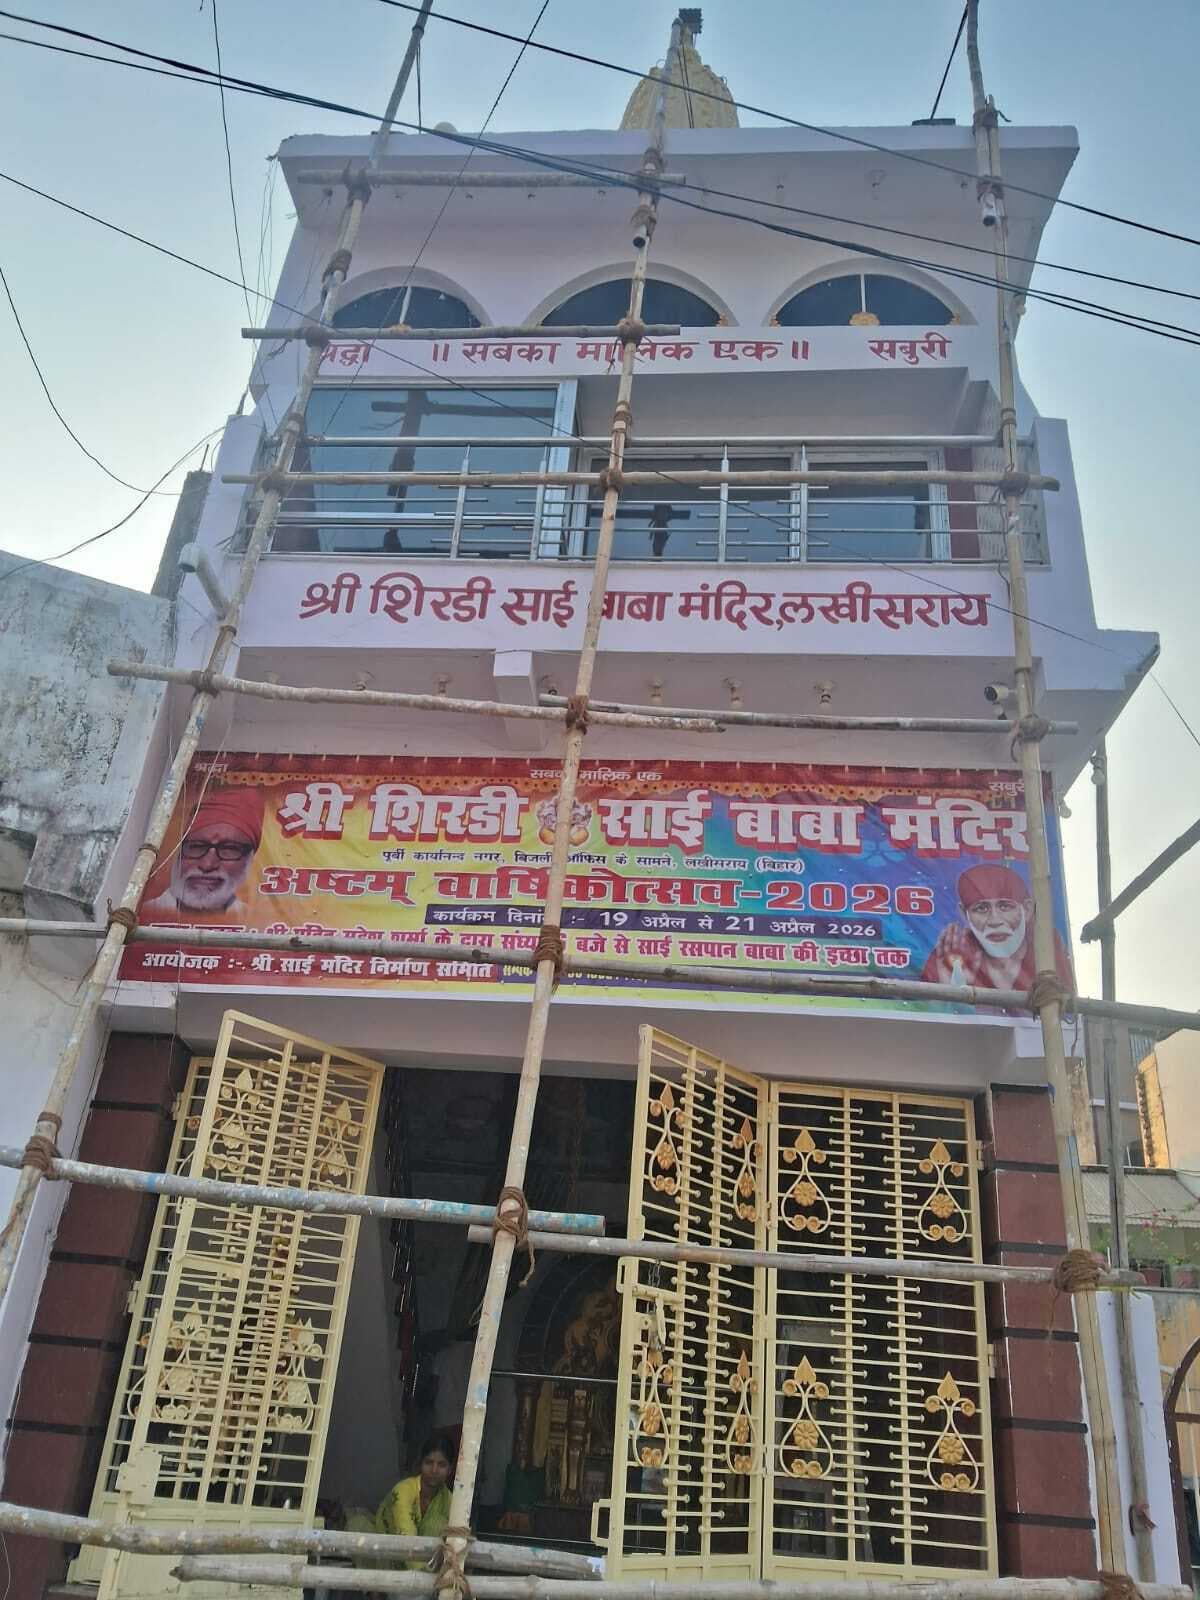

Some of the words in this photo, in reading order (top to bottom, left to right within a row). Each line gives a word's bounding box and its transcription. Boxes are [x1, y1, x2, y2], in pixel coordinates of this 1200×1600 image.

[462, 343, 561, 365] सबका
[709, 340, 784, 362] एक
[868, 332, 952, 366] सबुरी
[299, 572, 362, 619] श्री
[370, 571, 496, 623] शिरडी
[500, 580, 578, 628] साई
[579, 767, 633, 781] मालिक
[636, 771, 665, 782] एक
[277, 782, 354, 836] श्री
[370, 783, 528, 840] शिरडी
[598, 789, 712, 850] साई
[728, 802, 864, 849] बाबा
[882, 796, 1030, 855] मंदिर
[615, 853, 628, 865] के
[755, 856, 804, 873] (बिहार)
[433, 907, 496, 923] कार्यक्रम
[507, 907, 545, 923] दिनां
[599, 911, 629, 927] 19
[698, 916, 713, 930] से
[725, 915, 756, 931] 21
[828, 923, 877, 937] 2026
[142, 950, 223, 970] आयोजक
[251, 953, 275, 972] श्री
[280, 954, 316, 975] साई
[369, 956, 431, 977] निर्माण
[575, 933, 608, 953] बजे
[614, 934, 632, 954] से
[637, 935, 673, 958] साई
[679, 940, 738, 960] रसपान
[743, 942, 786, 962] बाबा
[792, 940, 818, 963] की
[825, 945, 870, 966] इच्छा
[875, 948, 911, 968] तक
